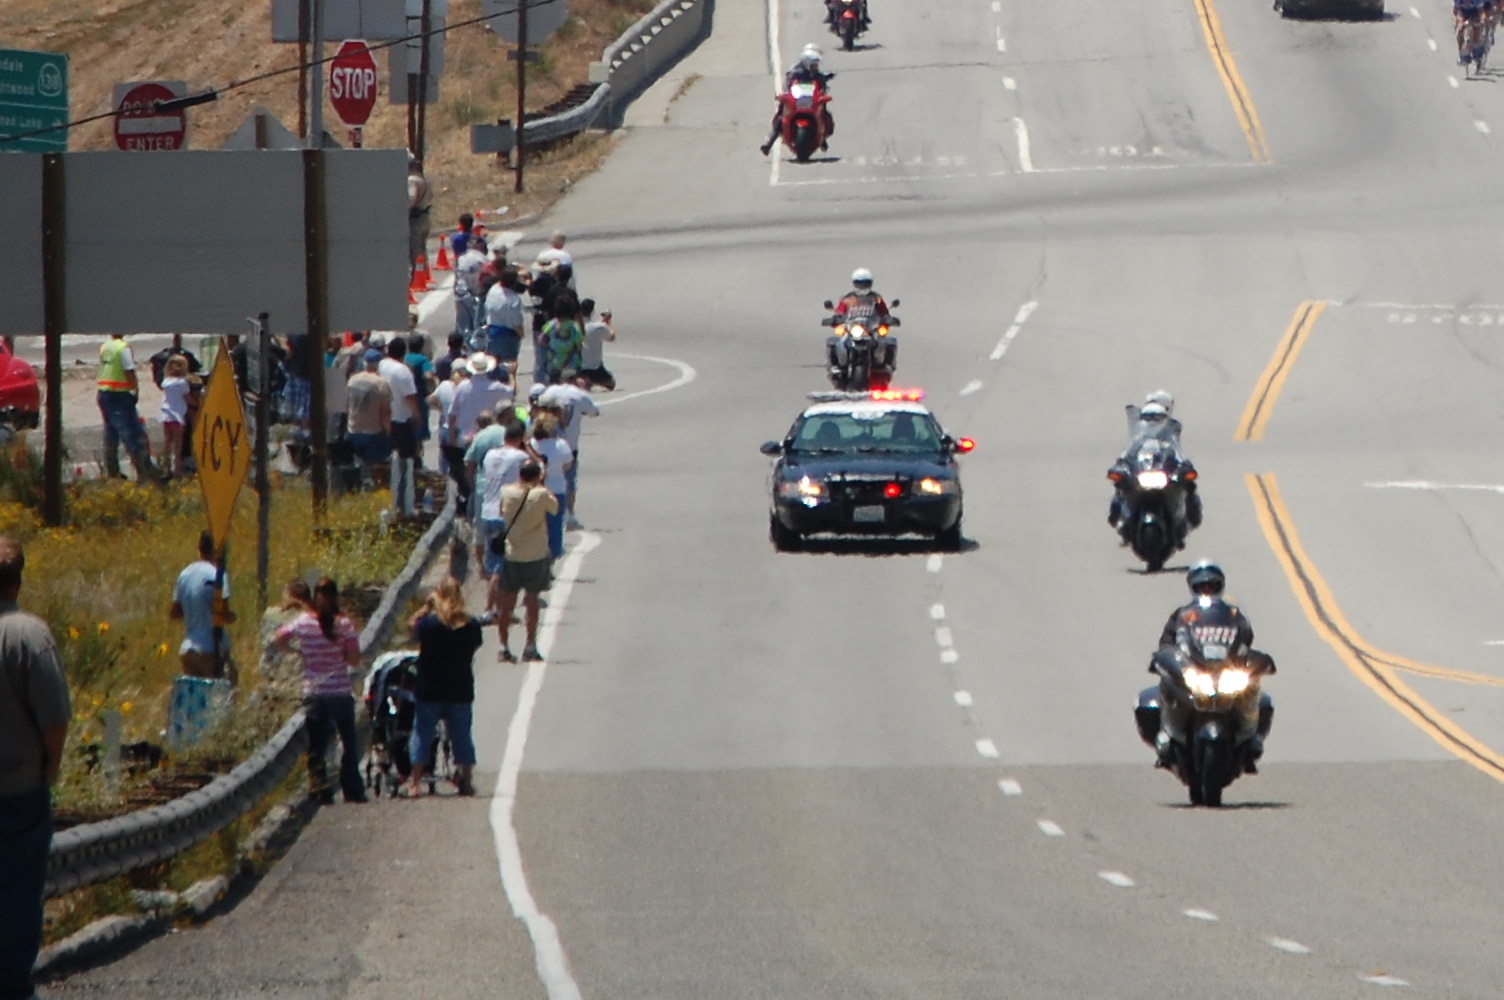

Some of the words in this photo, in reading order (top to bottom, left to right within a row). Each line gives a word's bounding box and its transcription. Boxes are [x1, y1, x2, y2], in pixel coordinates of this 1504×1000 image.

[332, 66, 375, 100] STOP
[126, 136, 174, 151] ENTER
[202, 414, 242, 476] ICY
